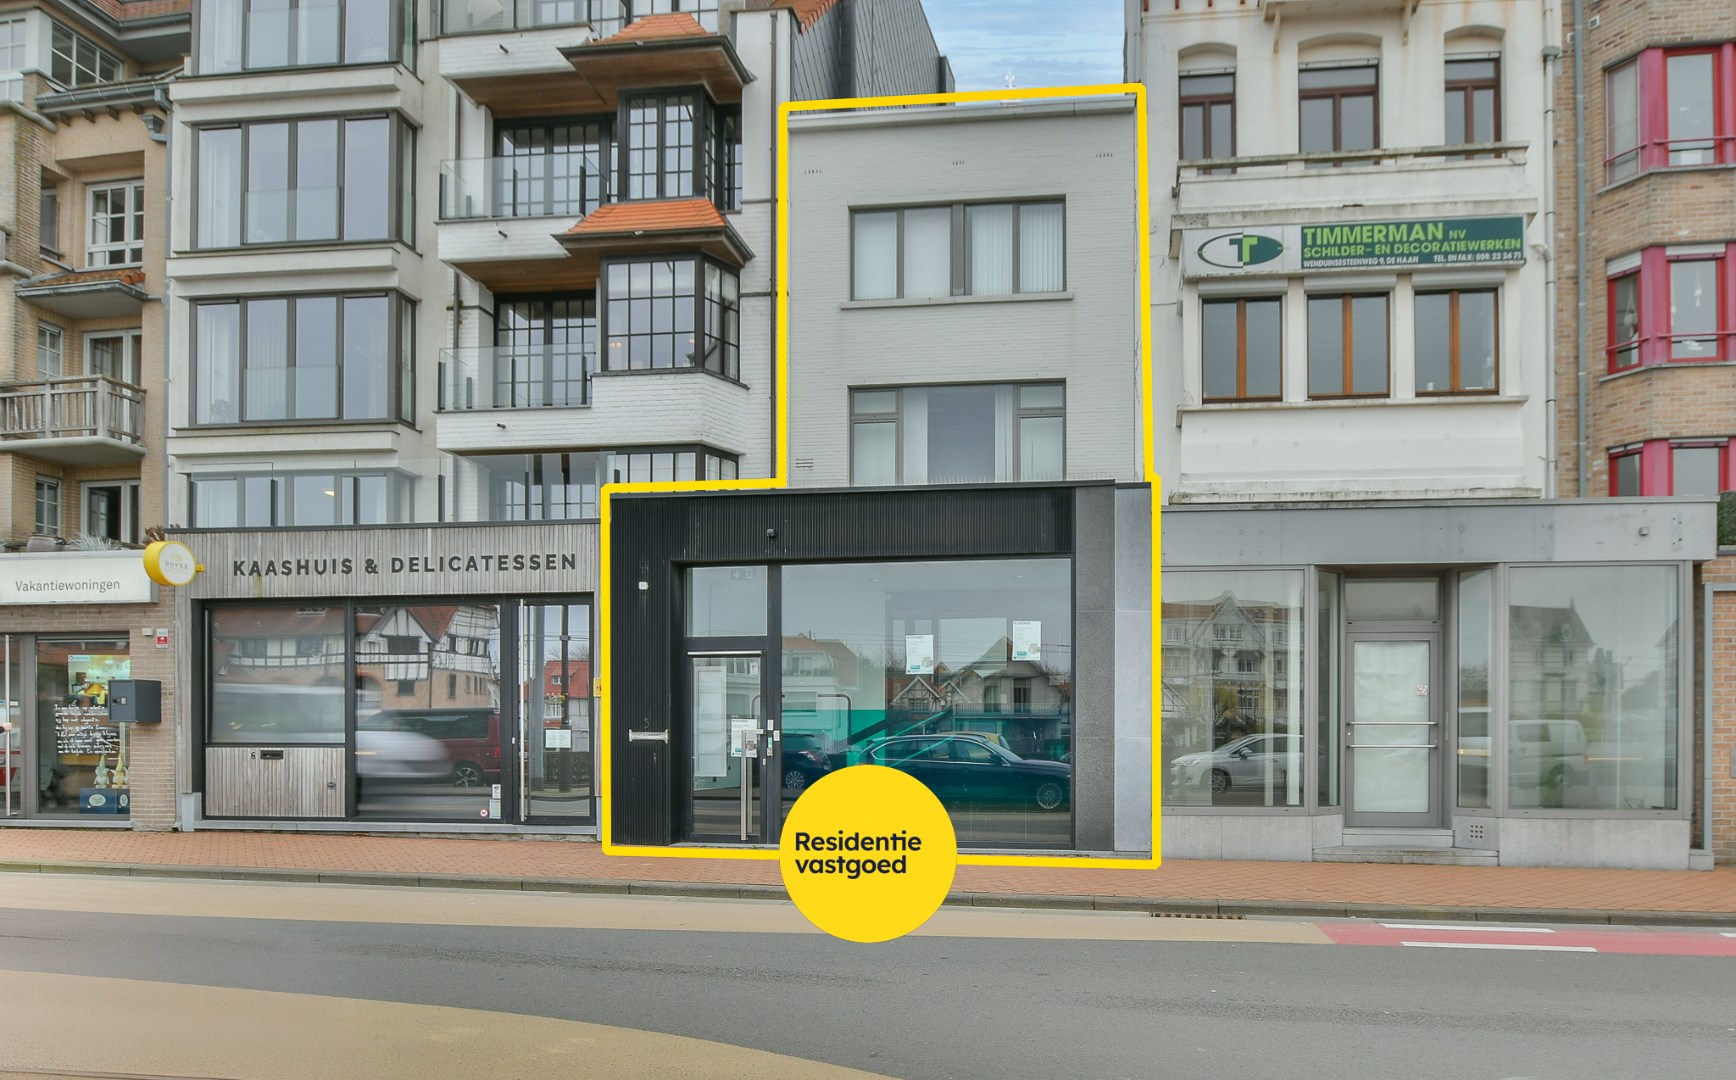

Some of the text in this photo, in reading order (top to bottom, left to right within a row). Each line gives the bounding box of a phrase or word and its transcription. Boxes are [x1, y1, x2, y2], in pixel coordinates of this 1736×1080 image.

[1303, 223, 1467, 246] TIMMERMAN NV
[1303, 238, 1521, 258] SCHILDER- EN DECORATIEWERKEN
[1303, 258, 1378, 268] WENDUINSESTEENWEG
[1397, 256, 1419, 264] HAAN
[1433, 255, 1447, 263] TEL.
[1448, 254, 1457, 262] EN
[1458, 254, 1475, 262] FAX:
[233, 553, 577, 577] KAASHUIS & DELICATESSEN
[15, 579, 120, 593] Vakantiewoningen
[251, 752, 256, 760] 6
